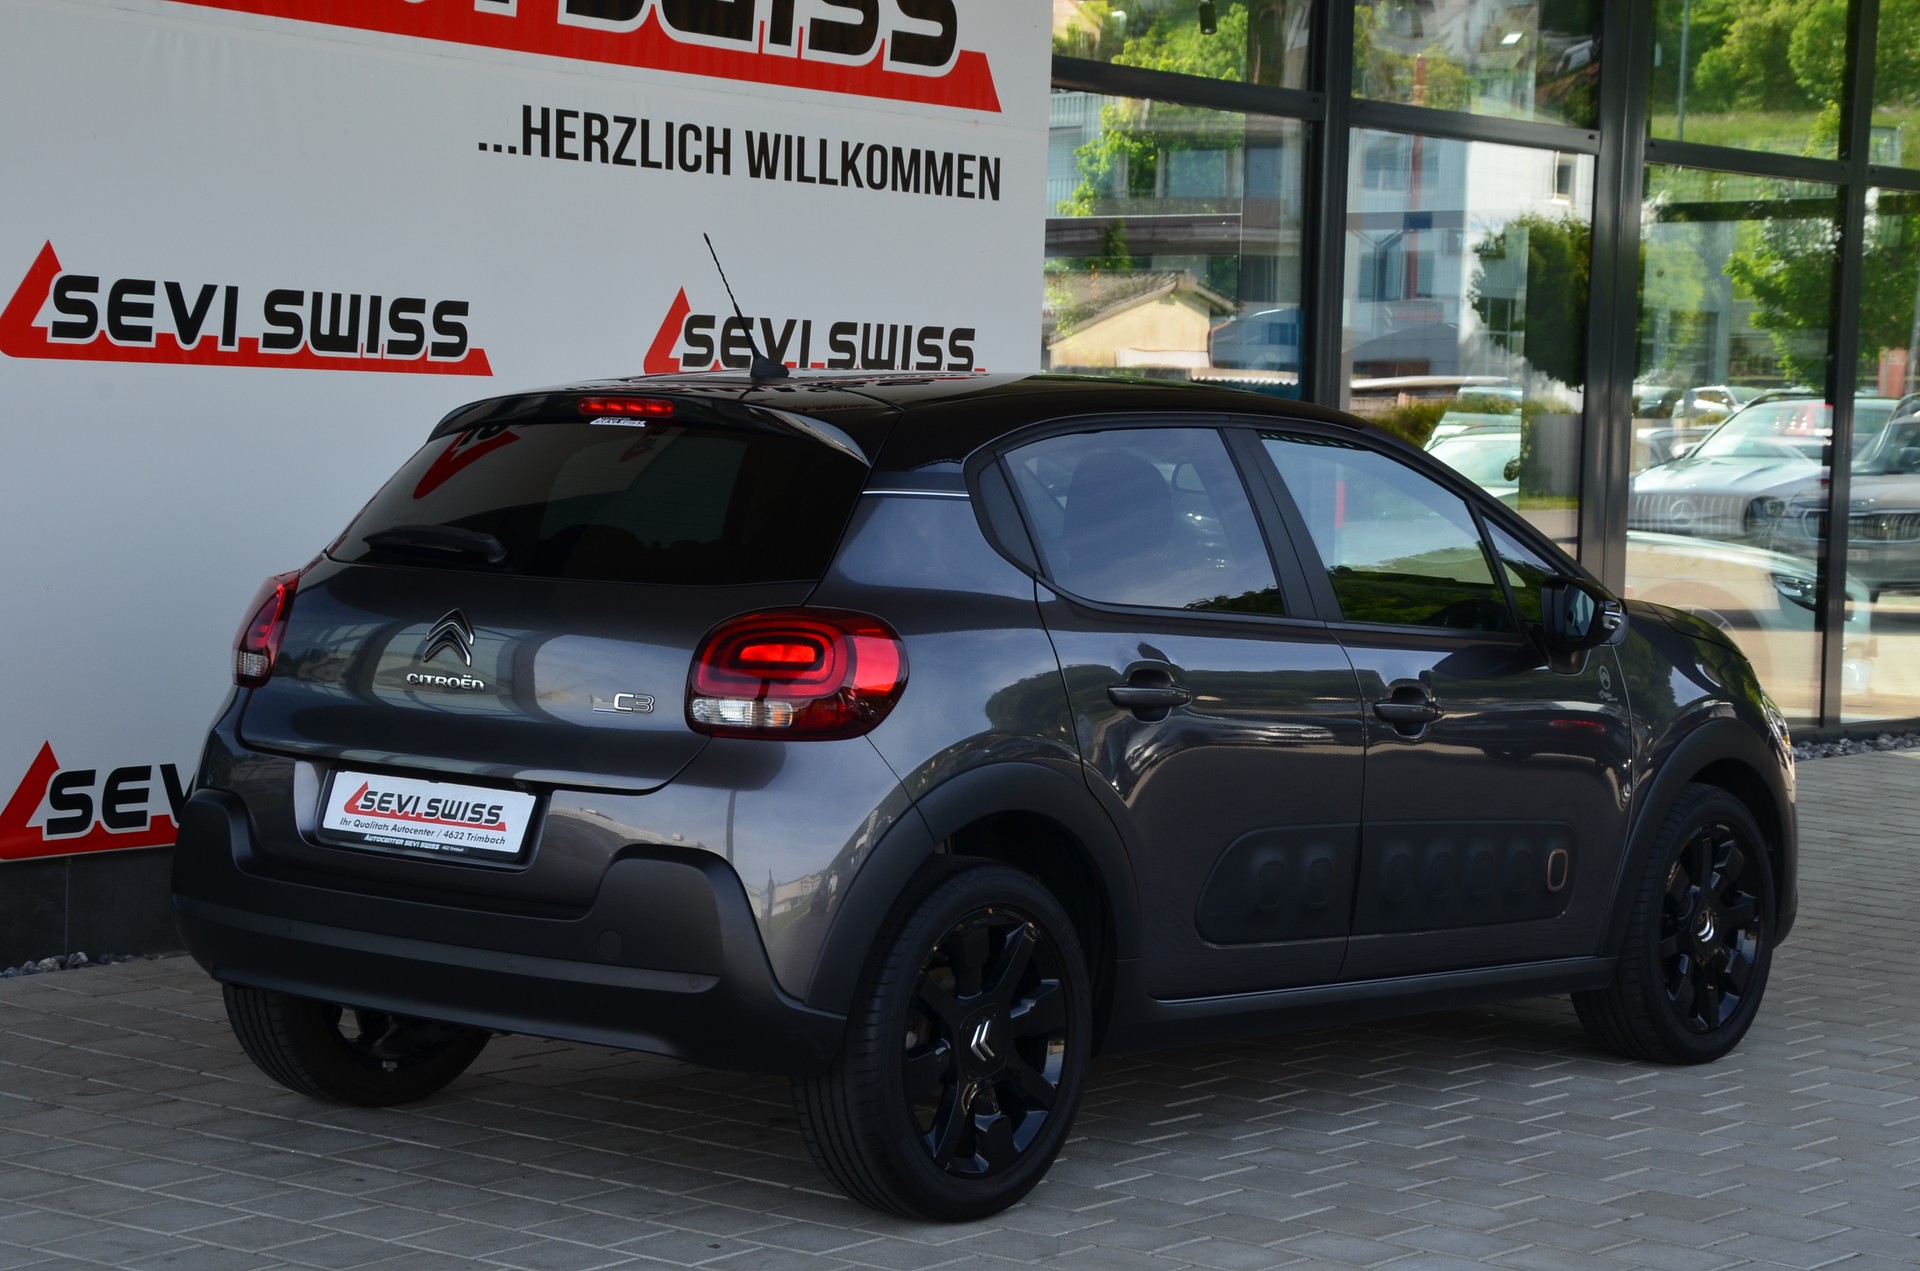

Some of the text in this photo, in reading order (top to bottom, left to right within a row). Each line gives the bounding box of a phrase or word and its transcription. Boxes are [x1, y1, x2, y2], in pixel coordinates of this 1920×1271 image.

[745, 130, 1001, 201] WILLKOMMEN
[51, 274, 470, 358] SEVI SWISS
[682, 314, 976, 371] SEVI SWISS
[406, 673, 485, 691] CITROËN
[614, 692, 655, 713] C3
[360, 790, 504, 825] SEVI SWISS
[340, 817, 352, 826] Ihr
[390, 824, 436, 837] Autocenter
[443, 831, 464, 840] 4632
[466, 833, 506, 845] Trimbach
